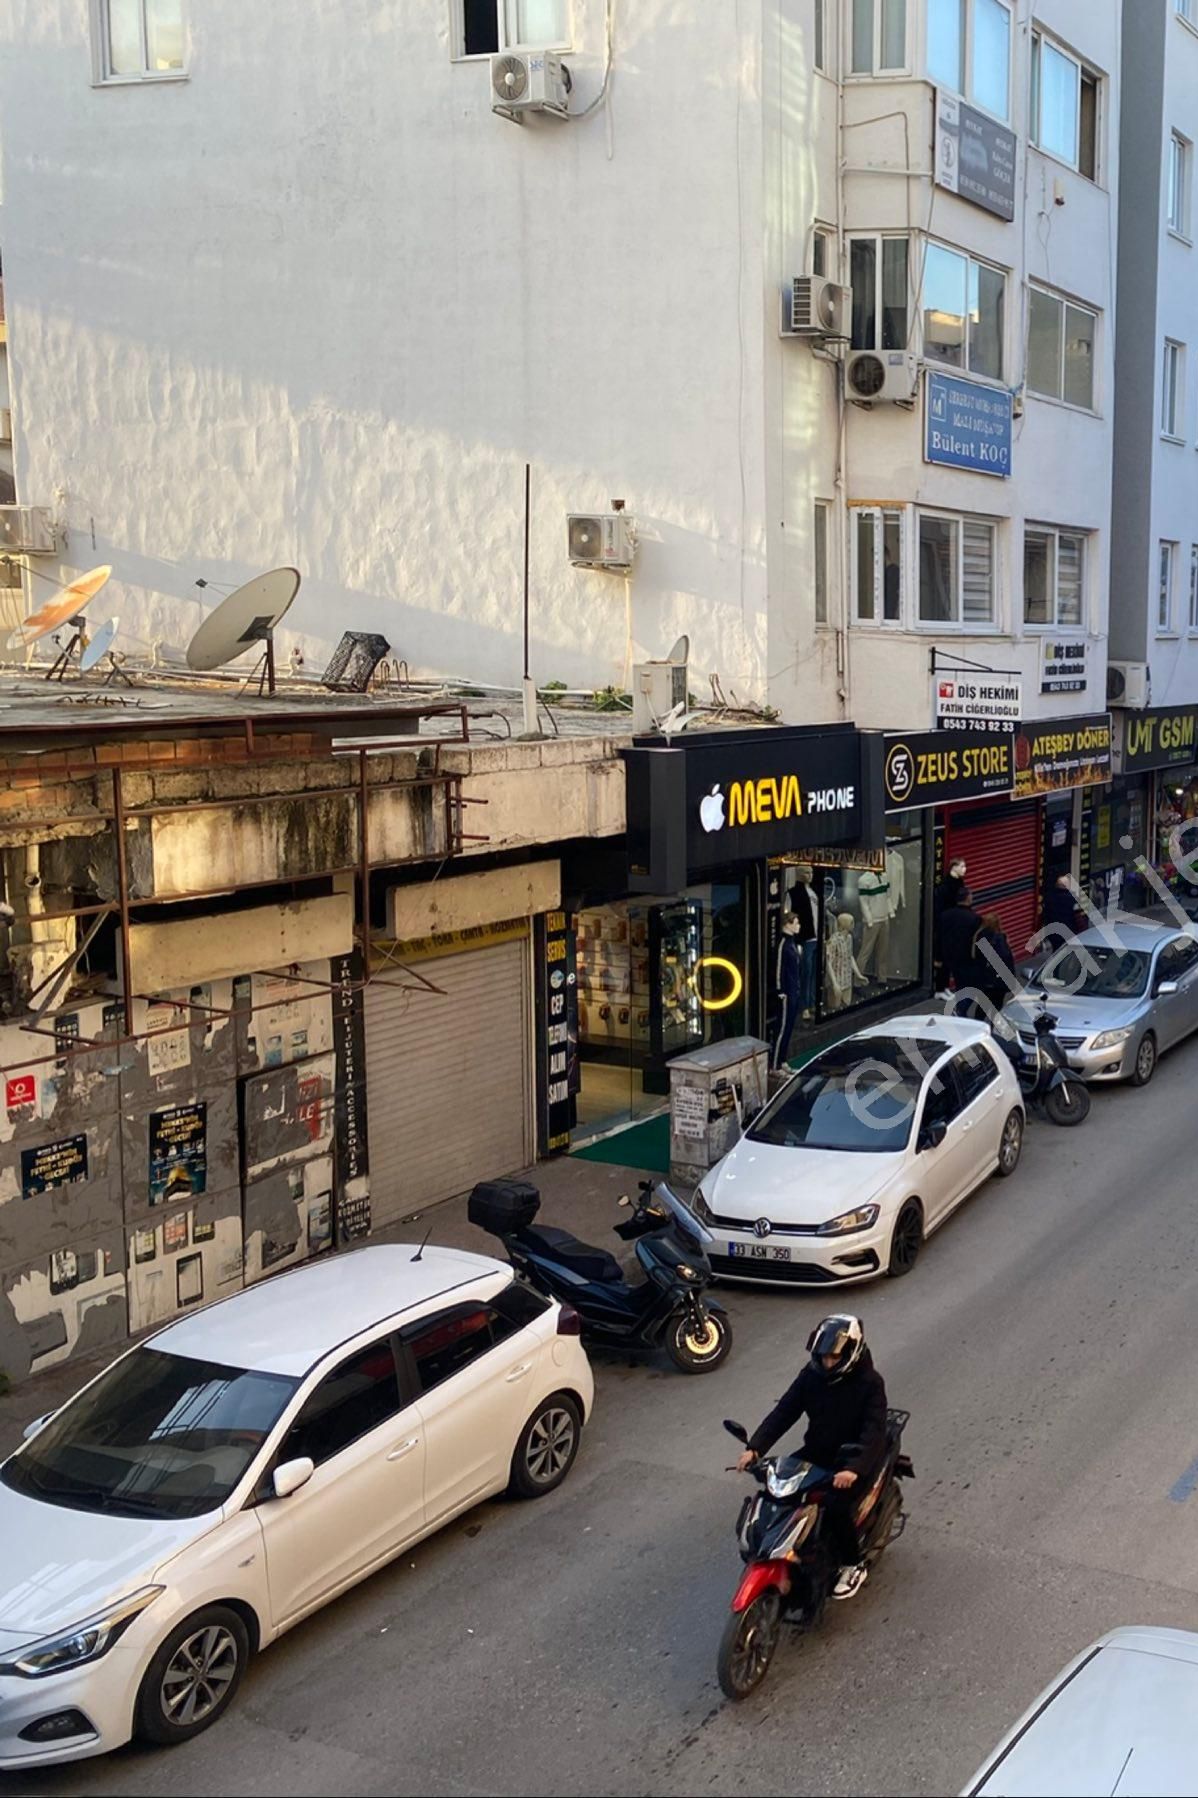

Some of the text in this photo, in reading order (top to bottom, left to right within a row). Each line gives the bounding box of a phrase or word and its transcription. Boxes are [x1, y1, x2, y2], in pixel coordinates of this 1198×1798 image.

[932, 431, 1008, 468] Bülent KOÇ
[958, 681, 1018, 701] DİŞ HEKİMİ
[968, 719, 986, 731] 743
[1002, 722, 1015, 733] 33
[1032, 726, 1109, 759] ATEŞBEY DÖNER
[1160, 715, 1194, 749] GSM
[917, 745, 1008, 785] ZEUS STORE
[728, 775, 855, 827] MEVA PHONE
[551, 993, 564, 1015] CEP
[736, 1243, 746, 1257] 33
[773, 1246, 790, 1260] 350
